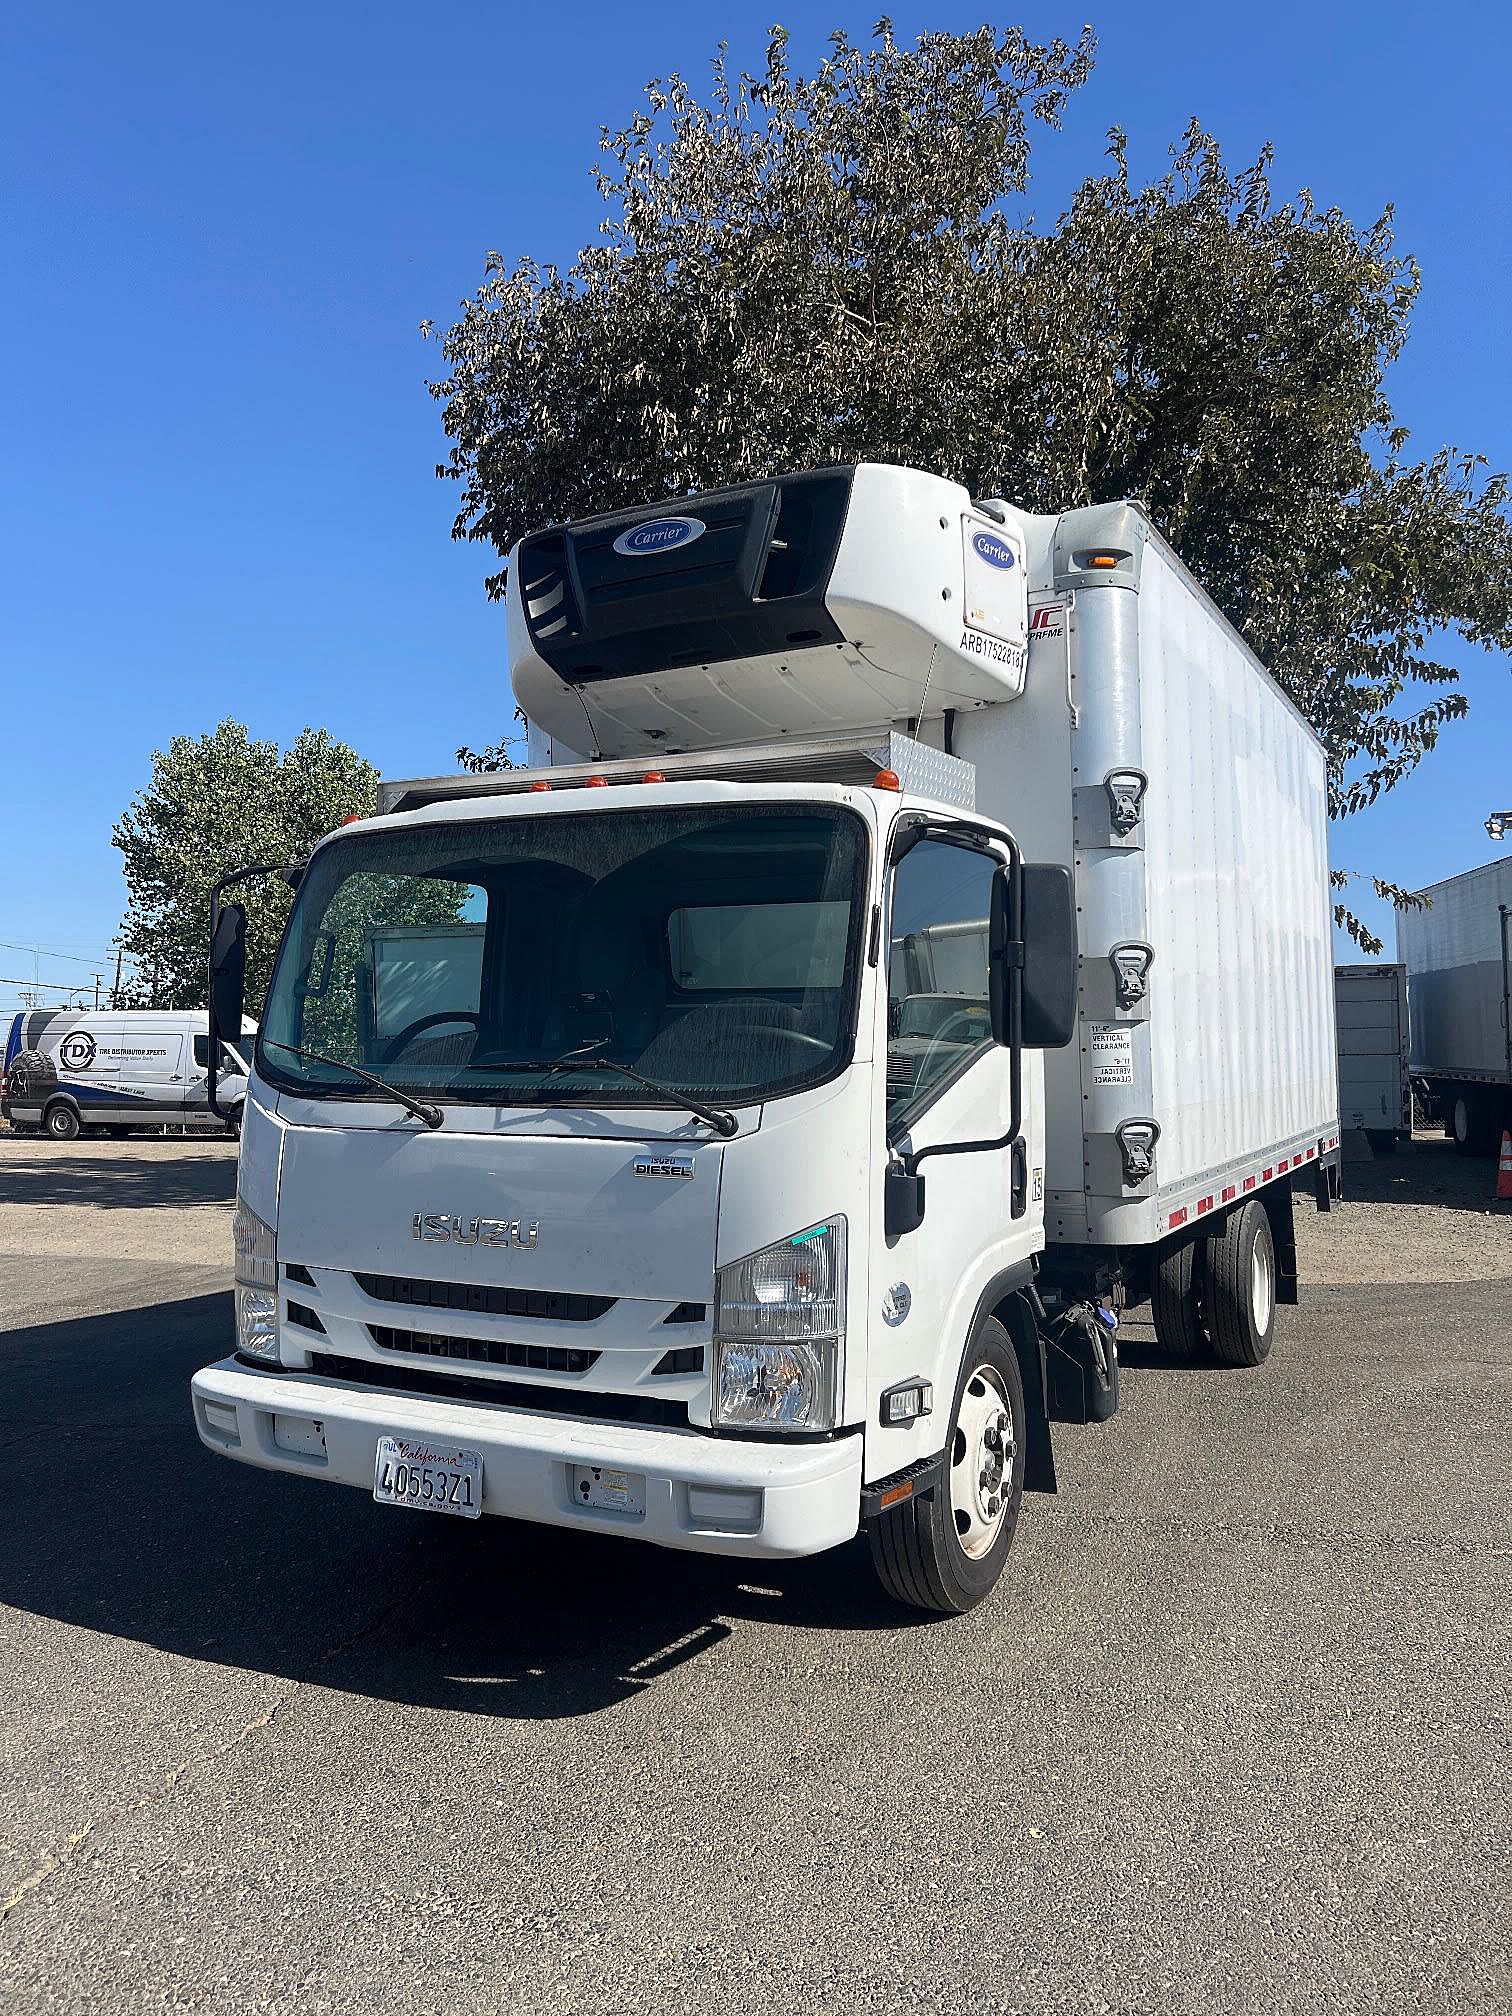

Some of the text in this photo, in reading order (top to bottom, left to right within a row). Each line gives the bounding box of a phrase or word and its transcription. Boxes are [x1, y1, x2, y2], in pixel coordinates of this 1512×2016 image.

[634, 527, 683, 546] Carrier
[977, 537, 1010, 562] Carrier
[1028, 627, 1064, 641] PREME
[60, 1043, 98, 1059] TDX
[636, 1164, 691, 1177] DIESEL
[650, 1157, 676, 1165] ISUZU
[412, 1212, 540, 1250] ISUZU
[400, 1444, 464, 1468] California
[381, 1463, 474, 1507] 40553Z1
